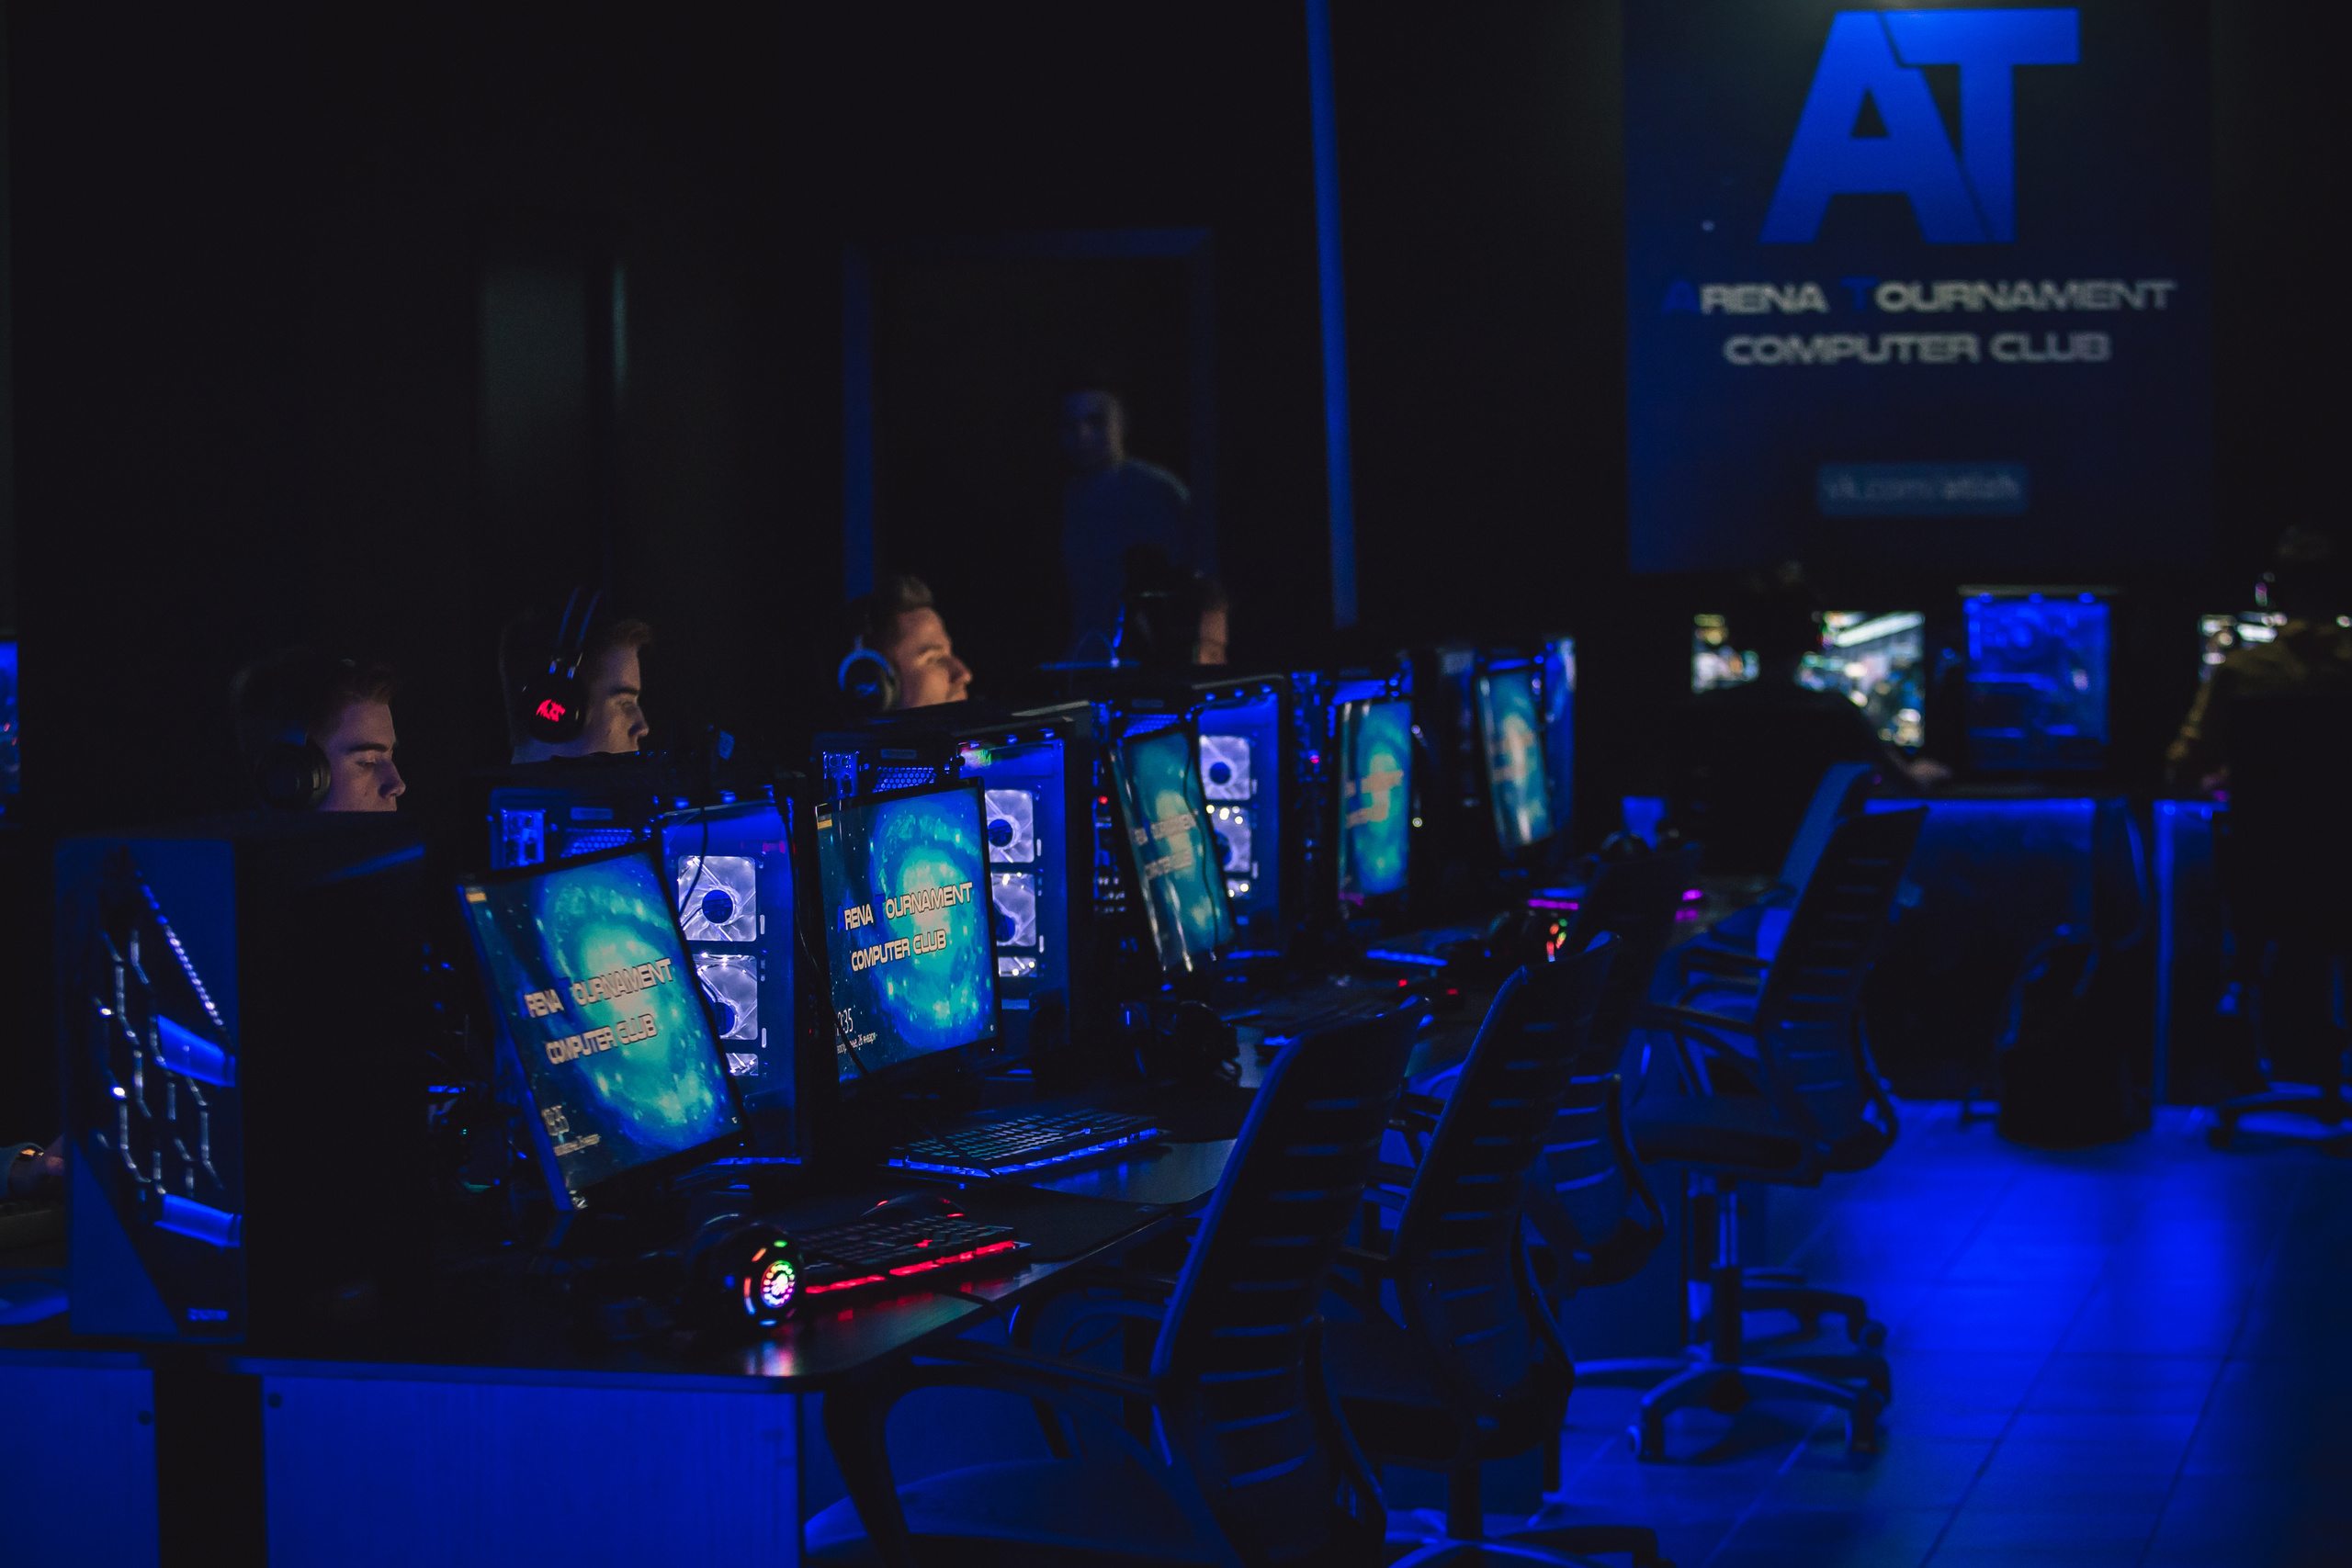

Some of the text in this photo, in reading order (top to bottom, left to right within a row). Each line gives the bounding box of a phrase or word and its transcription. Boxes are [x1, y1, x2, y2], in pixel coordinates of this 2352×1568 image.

[1758, 7, 2082, 243] AT
[1663, 276, 2177, 314] ARENA TOURNAMENT
[1724, 333, 2110, 365] COMPUTER CLUB
[851, 929, 947, 972] COMPUTER CLUB
[545, 1013, 658, 1065] COMPUTER CLUB
